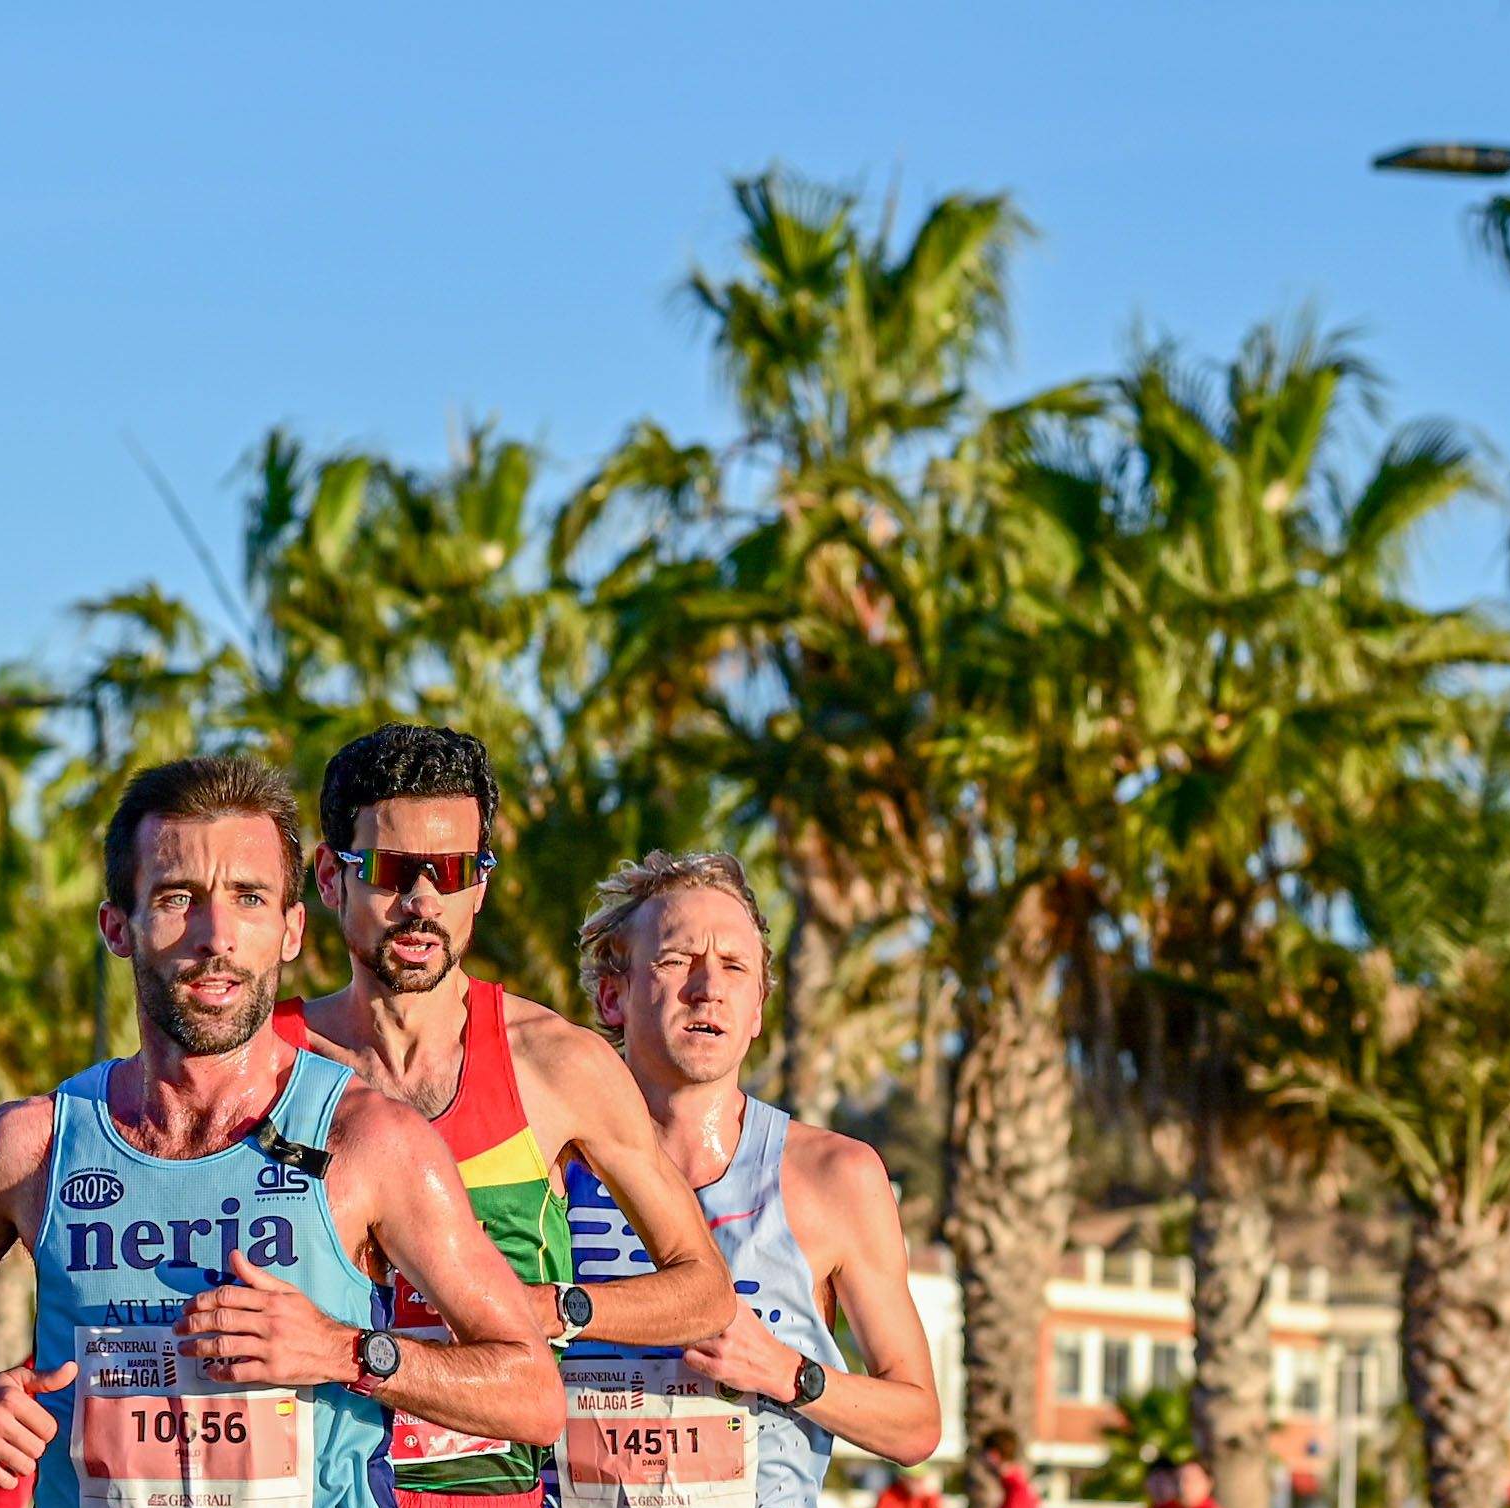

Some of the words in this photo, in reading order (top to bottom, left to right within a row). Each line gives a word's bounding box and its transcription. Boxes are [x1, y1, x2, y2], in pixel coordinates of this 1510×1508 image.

[64, 1176, 120, 1203] TROPS
[66, 1197, 299, 1287] nerja
[98, 1341, 157, 1353] GENERALI
[99, 1365, 160, 1388] MÁLAGA
[577, 1371, 627, 1382] GENERALI
[665, 1382, 699, 1395] 21K
[605, 1427, 699, 1455] 14511
[642, 1459, 665, 1467] DAVID
[168, 1493, 232, 1507] GENERALI
